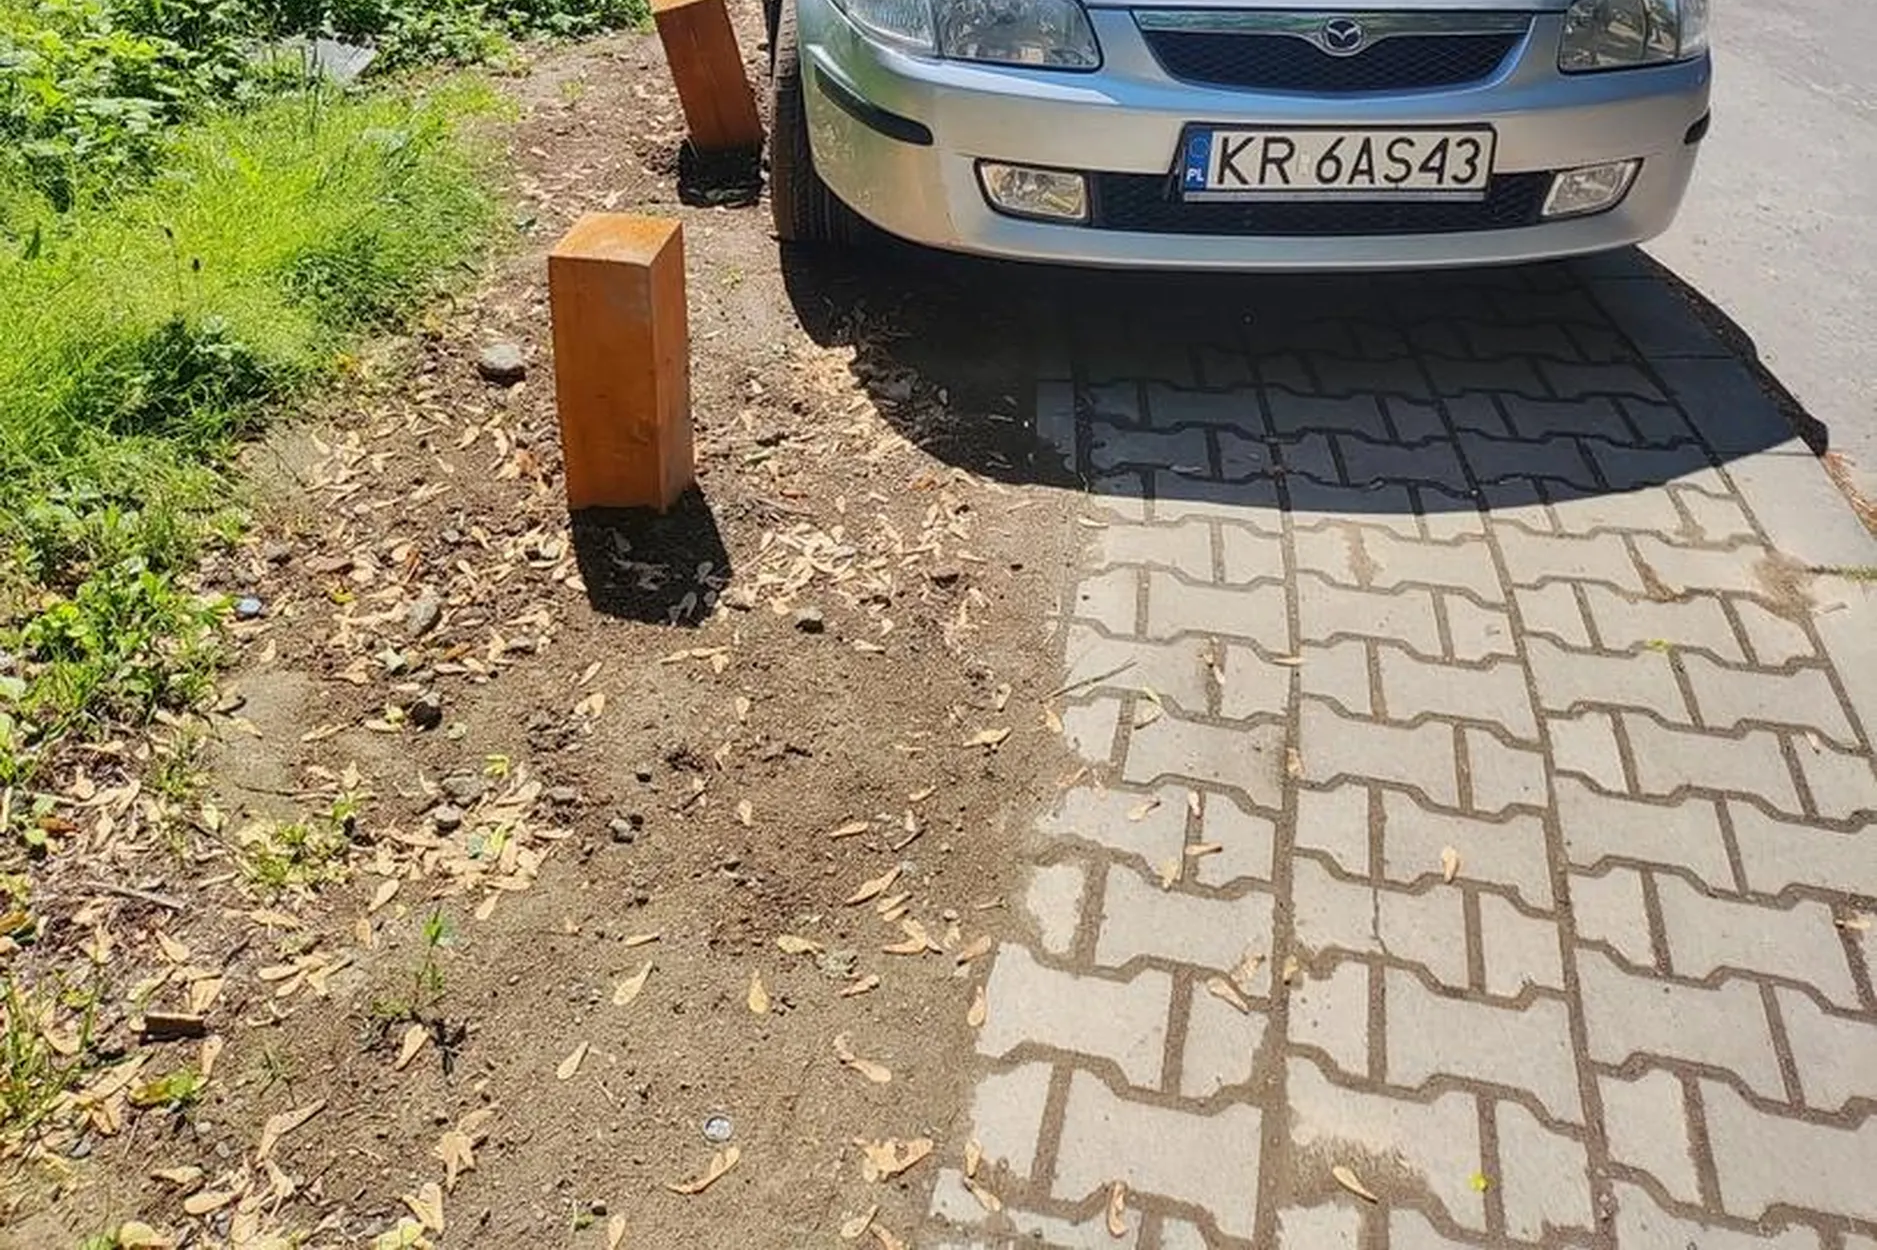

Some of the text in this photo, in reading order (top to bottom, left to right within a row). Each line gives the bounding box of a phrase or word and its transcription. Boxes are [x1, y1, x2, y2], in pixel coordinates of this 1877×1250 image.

[1186, 167, 1204, 182] PL
[1217, 136, 1481, 185] KR 6AS43
